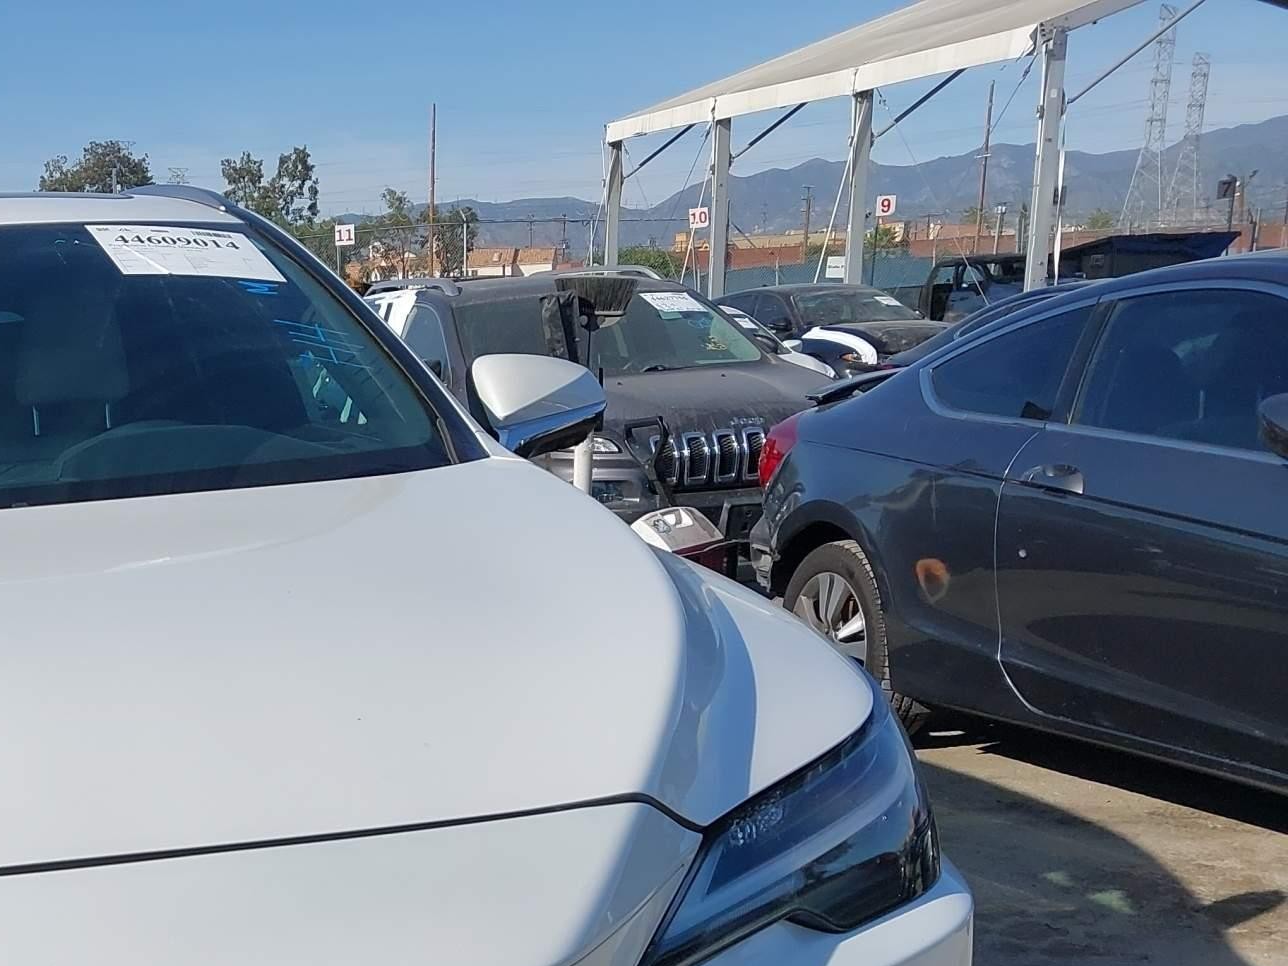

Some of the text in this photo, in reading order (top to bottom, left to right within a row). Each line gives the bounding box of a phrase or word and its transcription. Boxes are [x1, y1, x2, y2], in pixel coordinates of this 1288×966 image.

[881, 198, 891, 213] 9
[690, 211, 707, 224] 10
[336, 229, 353, 241] 11
[114, 235, 241, 250] 44609014
